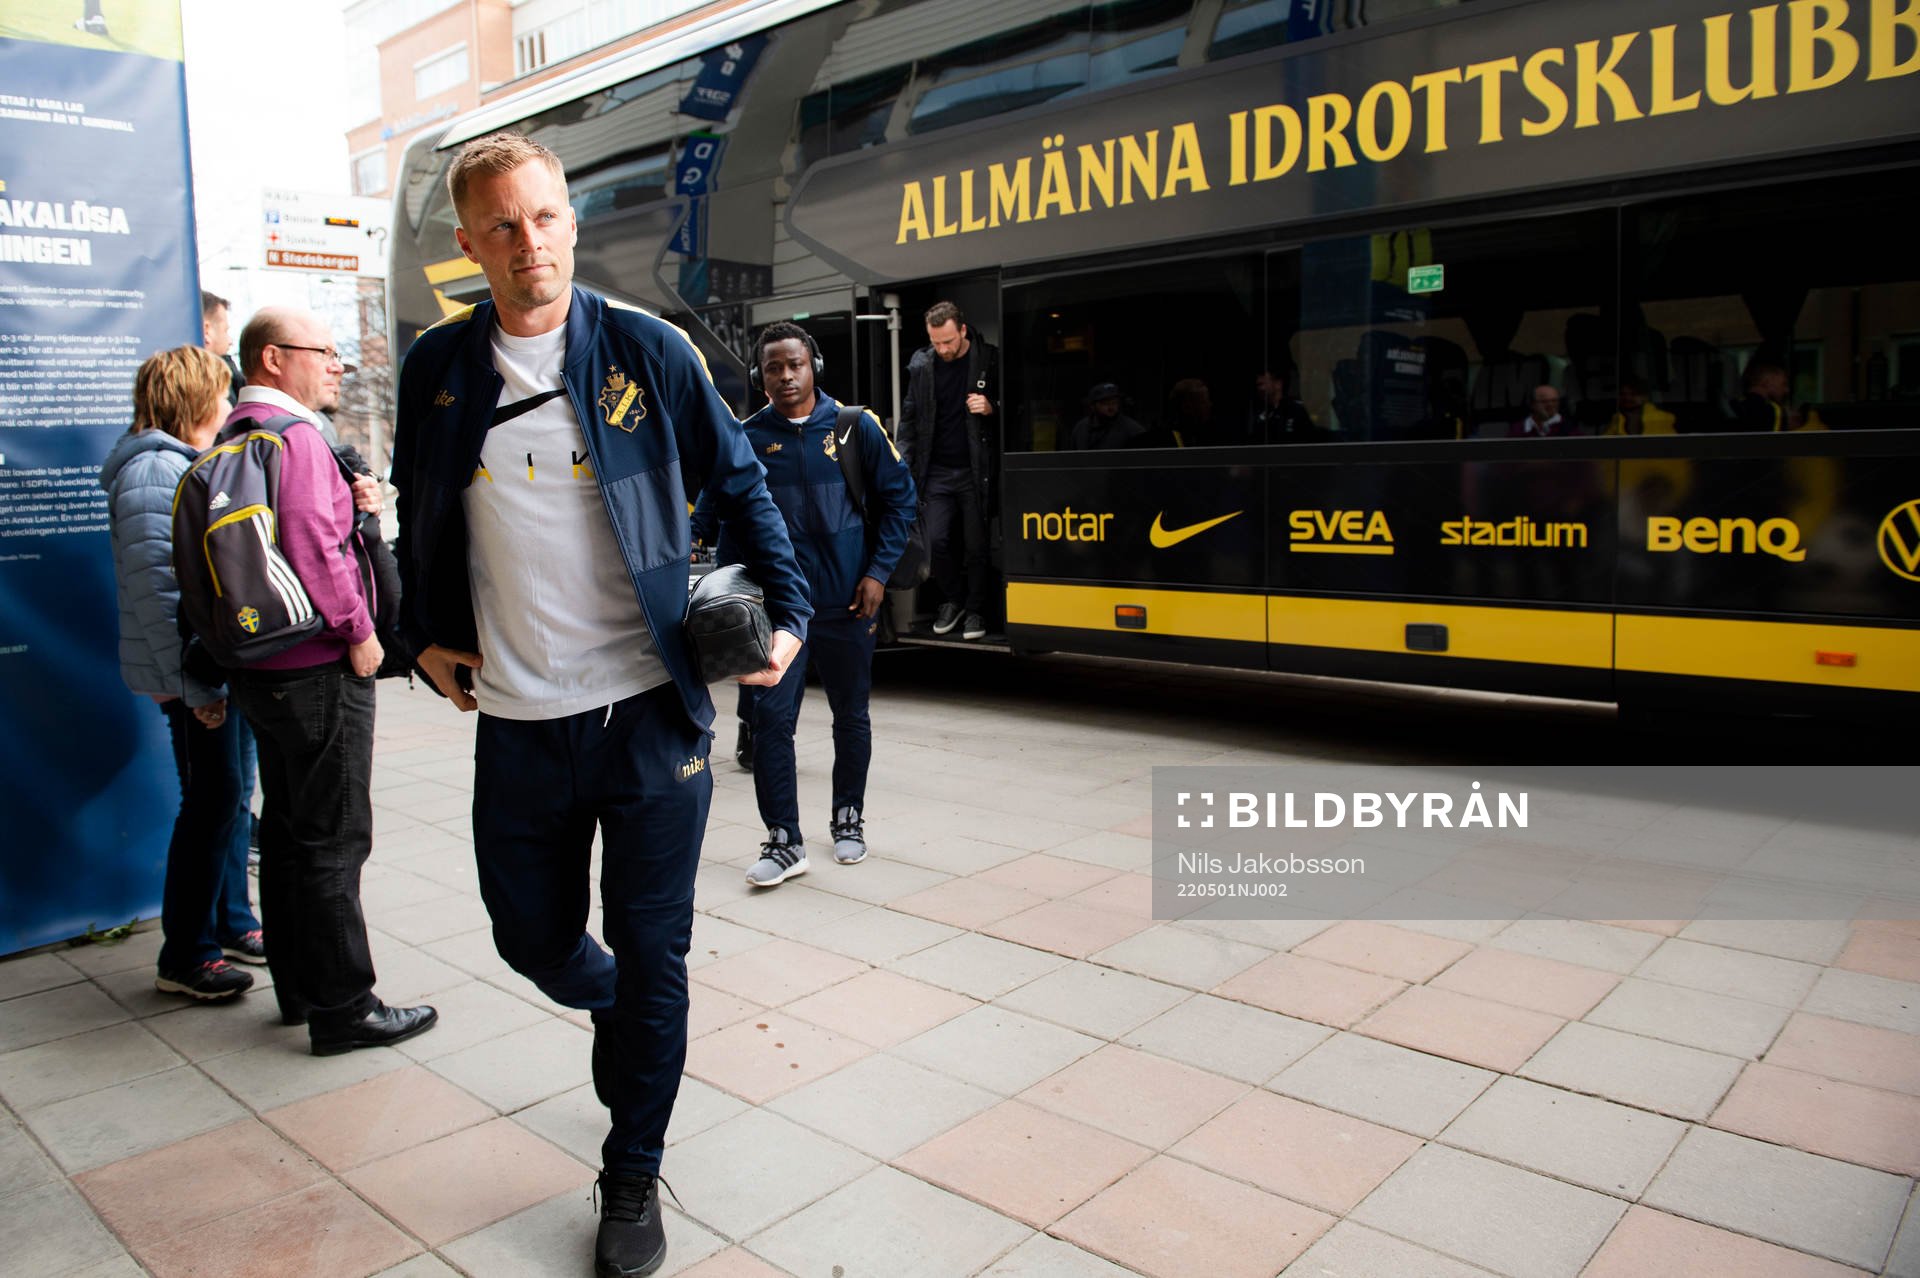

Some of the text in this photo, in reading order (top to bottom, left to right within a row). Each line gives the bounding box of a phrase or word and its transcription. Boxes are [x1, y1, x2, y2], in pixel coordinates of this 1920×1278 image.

[896, 0, 1920, 245] ALLMÄNNA IDROTTSKLUBB
[0, 234, 92, 266] INGEN
[1022, 506, 1114, 542] notar
[1289, 510, 1394, 543] SVEA
[1440, 515, 1588, 548] stadium
[683, 756, 705, 778] nike
